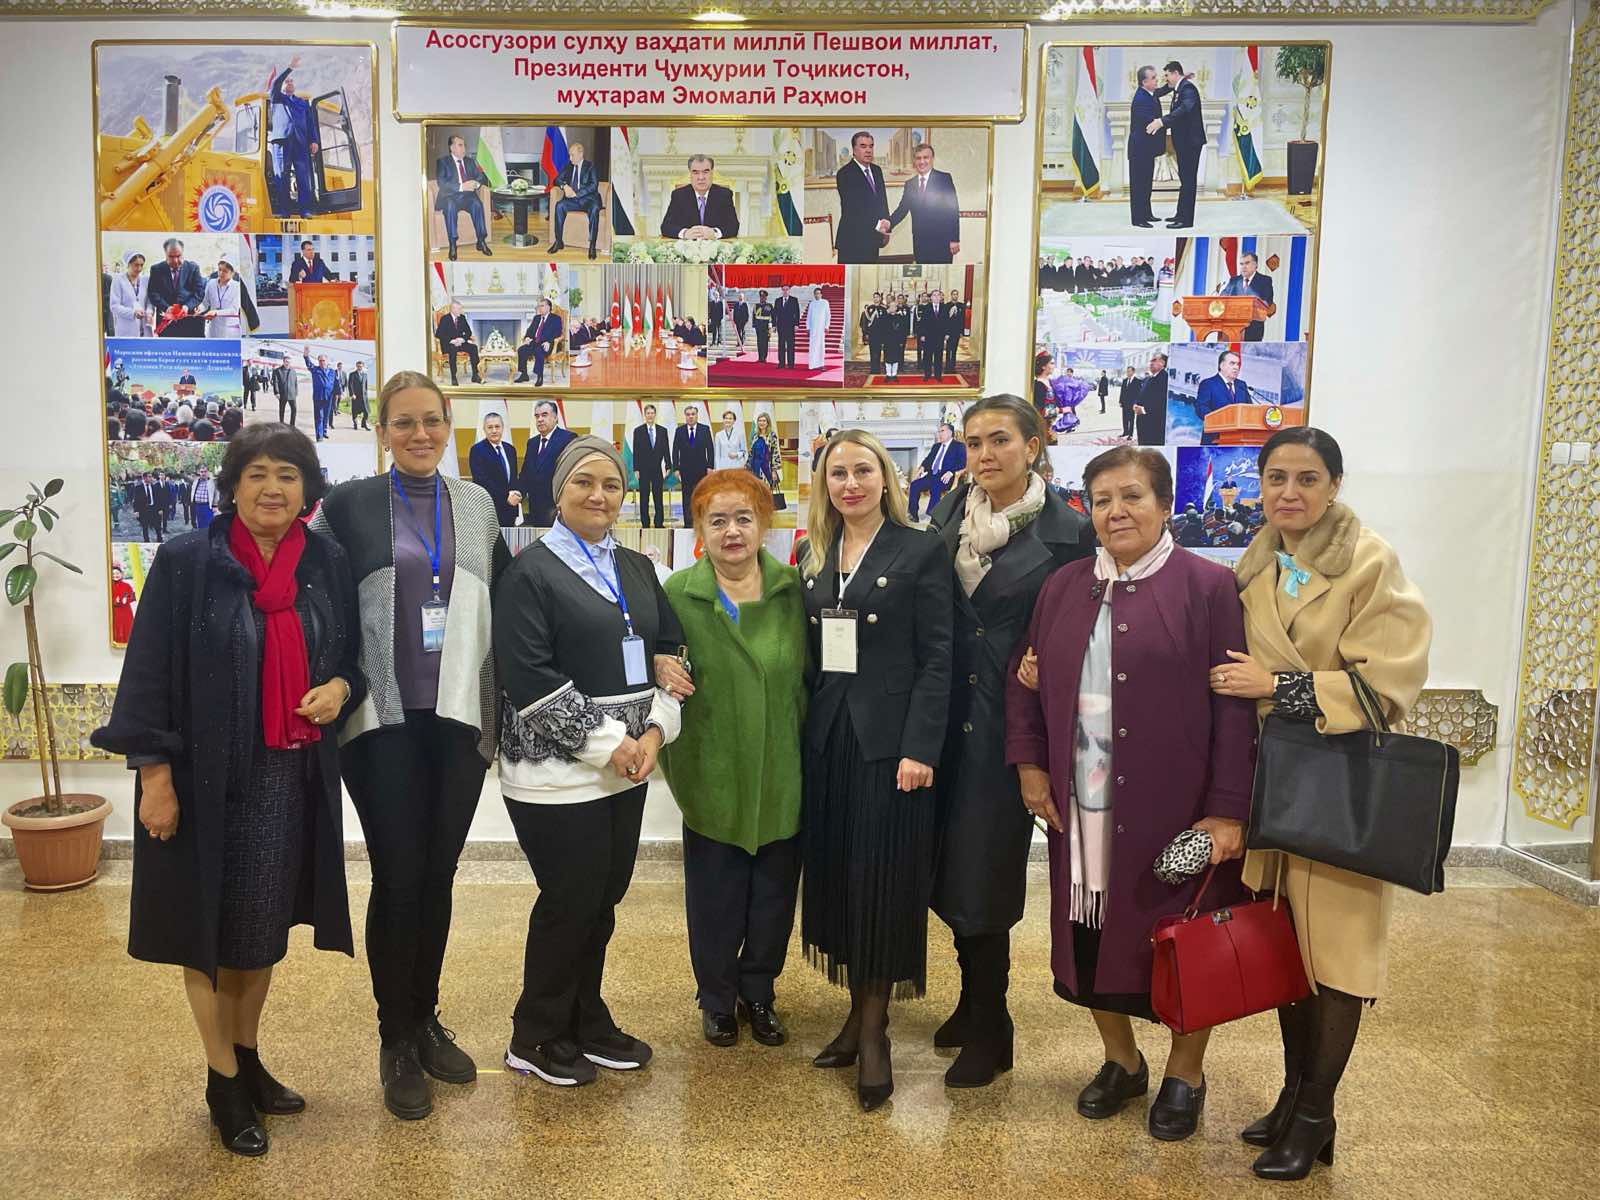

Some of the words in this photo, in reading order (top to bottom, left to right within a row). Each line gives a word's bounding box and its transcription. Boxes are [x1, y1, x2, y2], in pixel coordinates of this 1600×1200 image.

[425, 30, 557, 53] Асосгузори
[563, 34, 628, 55] сулҳу
[635, 35, 726, 54] ваҳдати
[733, 33, 806, 51] миллӣ
[813, 32, 902, 51] Пешвои
[909, 35, 998, 53] миллат,
[514, 58, 647, 80] Президенти
[655, 59, 766, 82] Ҷумҳурии
[773, 59, 910, 80] Тоҷикистон,
[556, 89, 665, 108] муҳтарам
[672, 86, 777, 105] Эмомалӣ
[783, 86, 867, 106] Раҳмон
